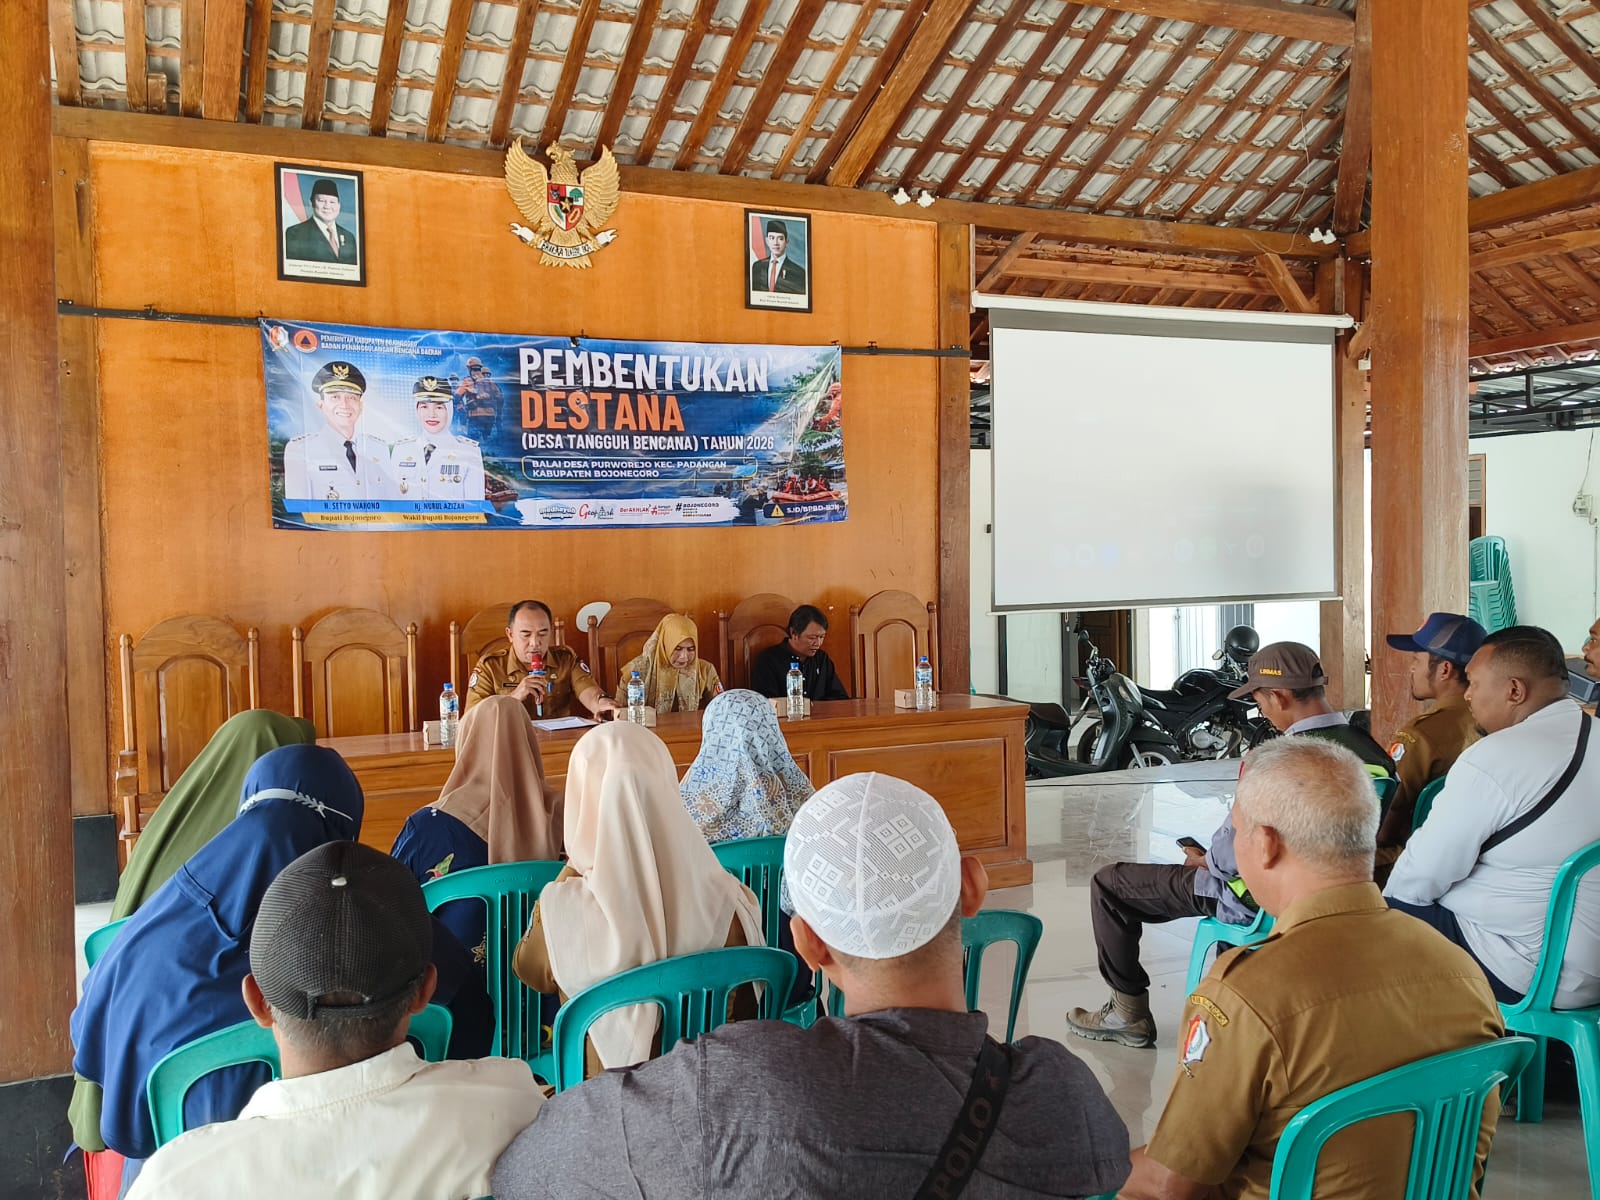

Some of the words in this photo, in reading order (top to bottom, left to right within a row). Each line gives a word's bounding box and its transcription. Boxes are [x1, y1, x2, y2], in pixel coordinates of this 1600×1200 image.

[519, 347, 769, 392] PEMBENTUKAN
[521, 390, 685, 432] DESTANA
[522, 432, 564, 450] (DESA
[567, 433, 630, 450] TANGGUH
[633, 435, 699, 452] BENCANA)
[701, 436, 744, 450] TAHUN
[746, 435, 774, 450] 2026
[532, 460, 562, 469] BALAI
[563, 460, 589, 469] DESA
[591, 461, 652, 469] PURWOREJO
[654, 461, 676, 469] KEC.
[677, 461, 727, 469] PADANGAN
[532, 470, 592, 478] KABUPATEN
[594, 470, 660, 478] BOJONEGORO
[332, 502, 351, 510] SETYO
